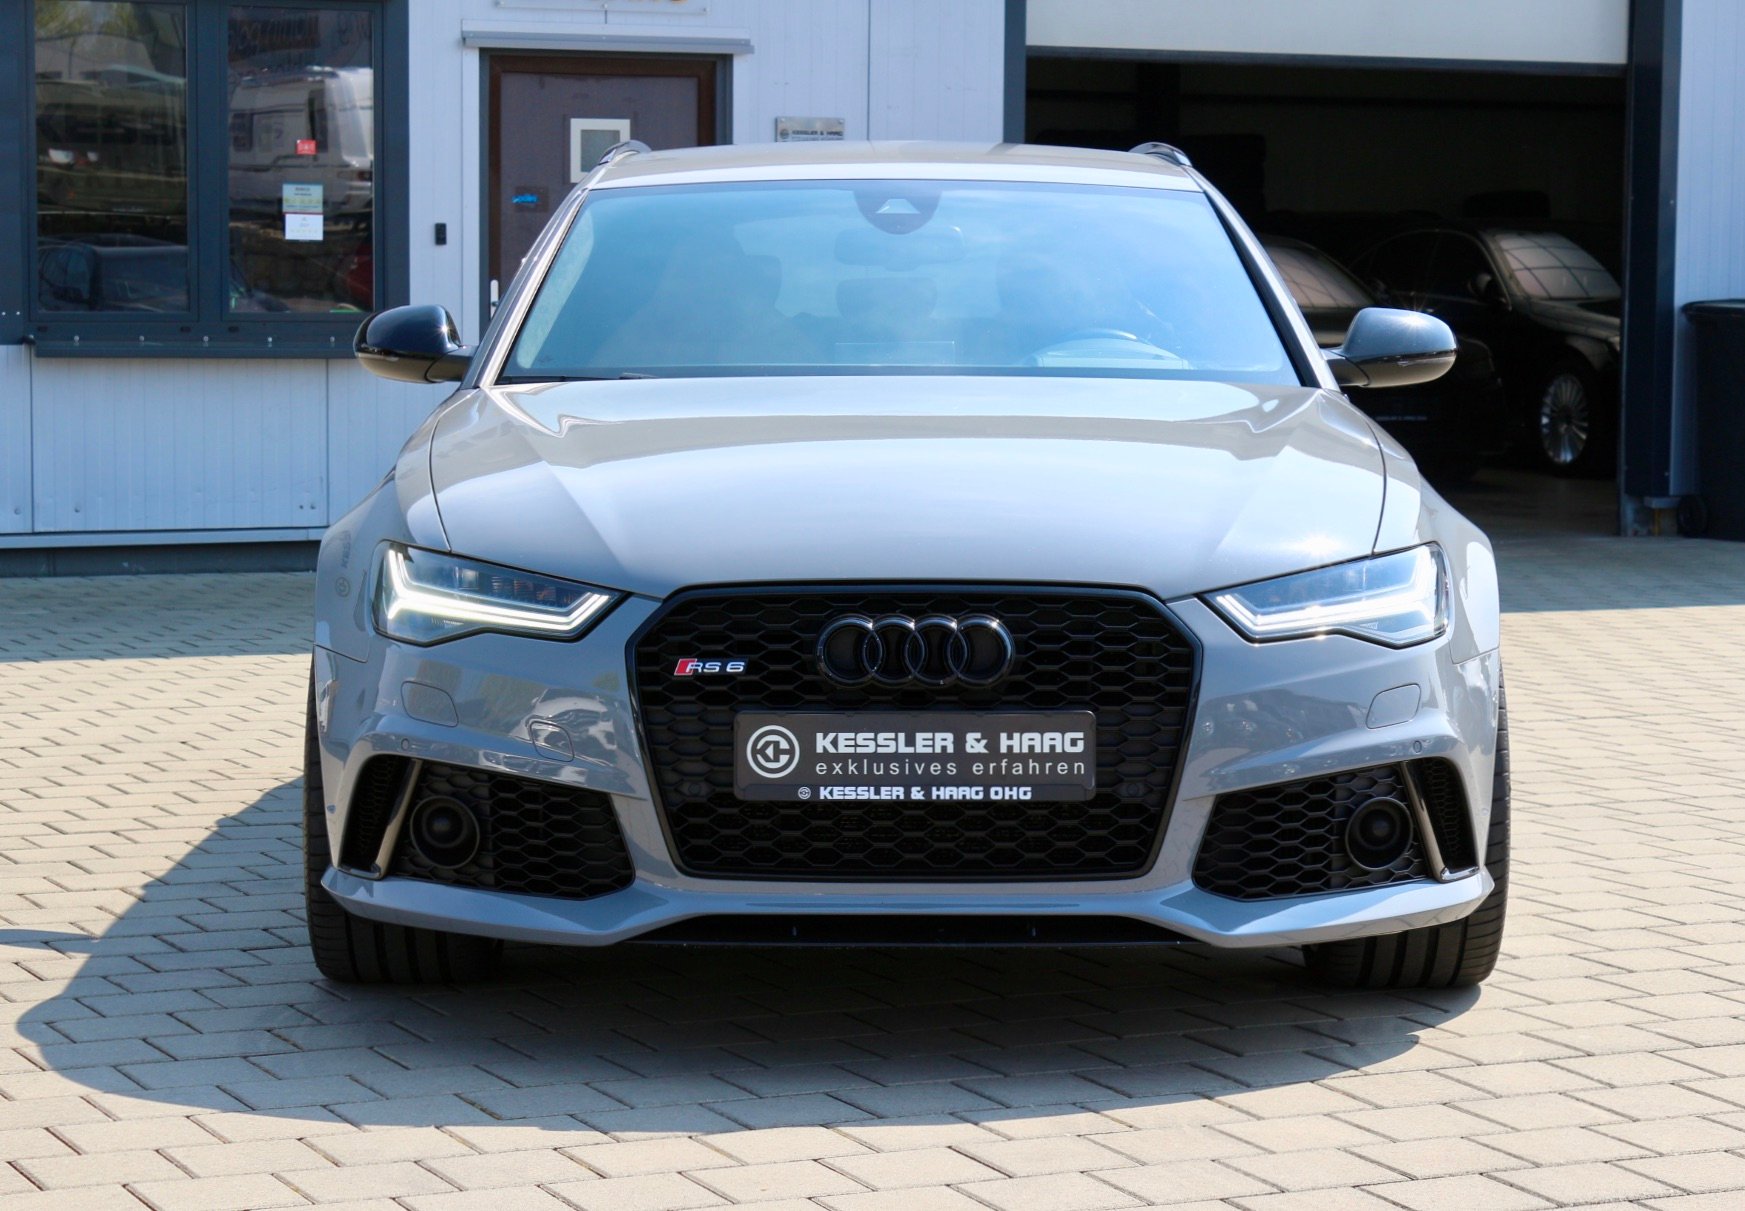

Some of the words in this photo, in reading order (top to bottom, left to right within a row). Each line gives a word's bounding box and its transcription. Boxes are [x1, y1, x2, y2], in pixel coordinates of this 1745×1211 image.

[815, 732, 954, 754] KESSLER
[965, 732, 989, 754] &
[999, 732, 1085, 754] HAAG
[815, 758, 957, 776] exklusives
[972, 758, 1085, 776] erfahren
[819, 786, 905, 801] KESSLER
[910, 786, 926, 801] &
[931, 786, 984, 801] HAAG
[989, 786, 1032, 801] OHG
